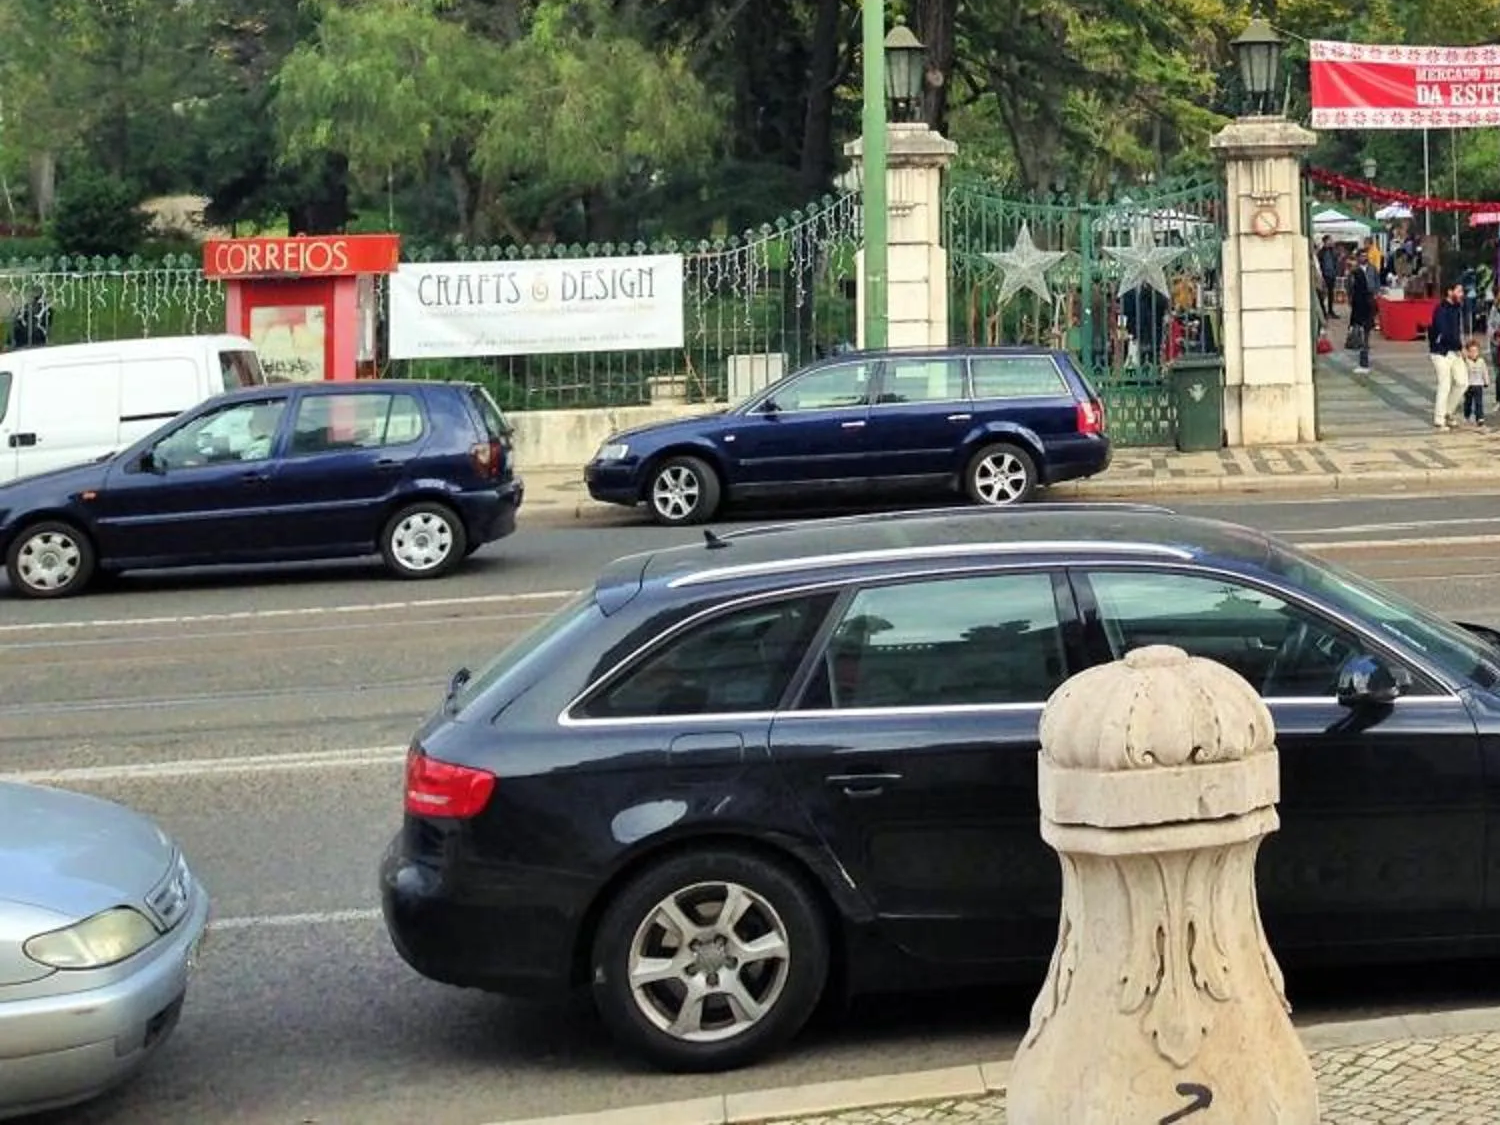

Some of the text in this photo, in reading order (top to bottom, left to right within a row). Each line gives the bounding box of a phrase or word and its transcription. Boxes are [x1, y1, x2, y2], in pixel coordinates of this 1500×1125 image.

[1416, 83, 1444, 105] DA
[215, 241, 348, 274] CORREIOS
[417, 272, 521, 306] CRAFTS
[560, 267, 655, 301] DESIGN
